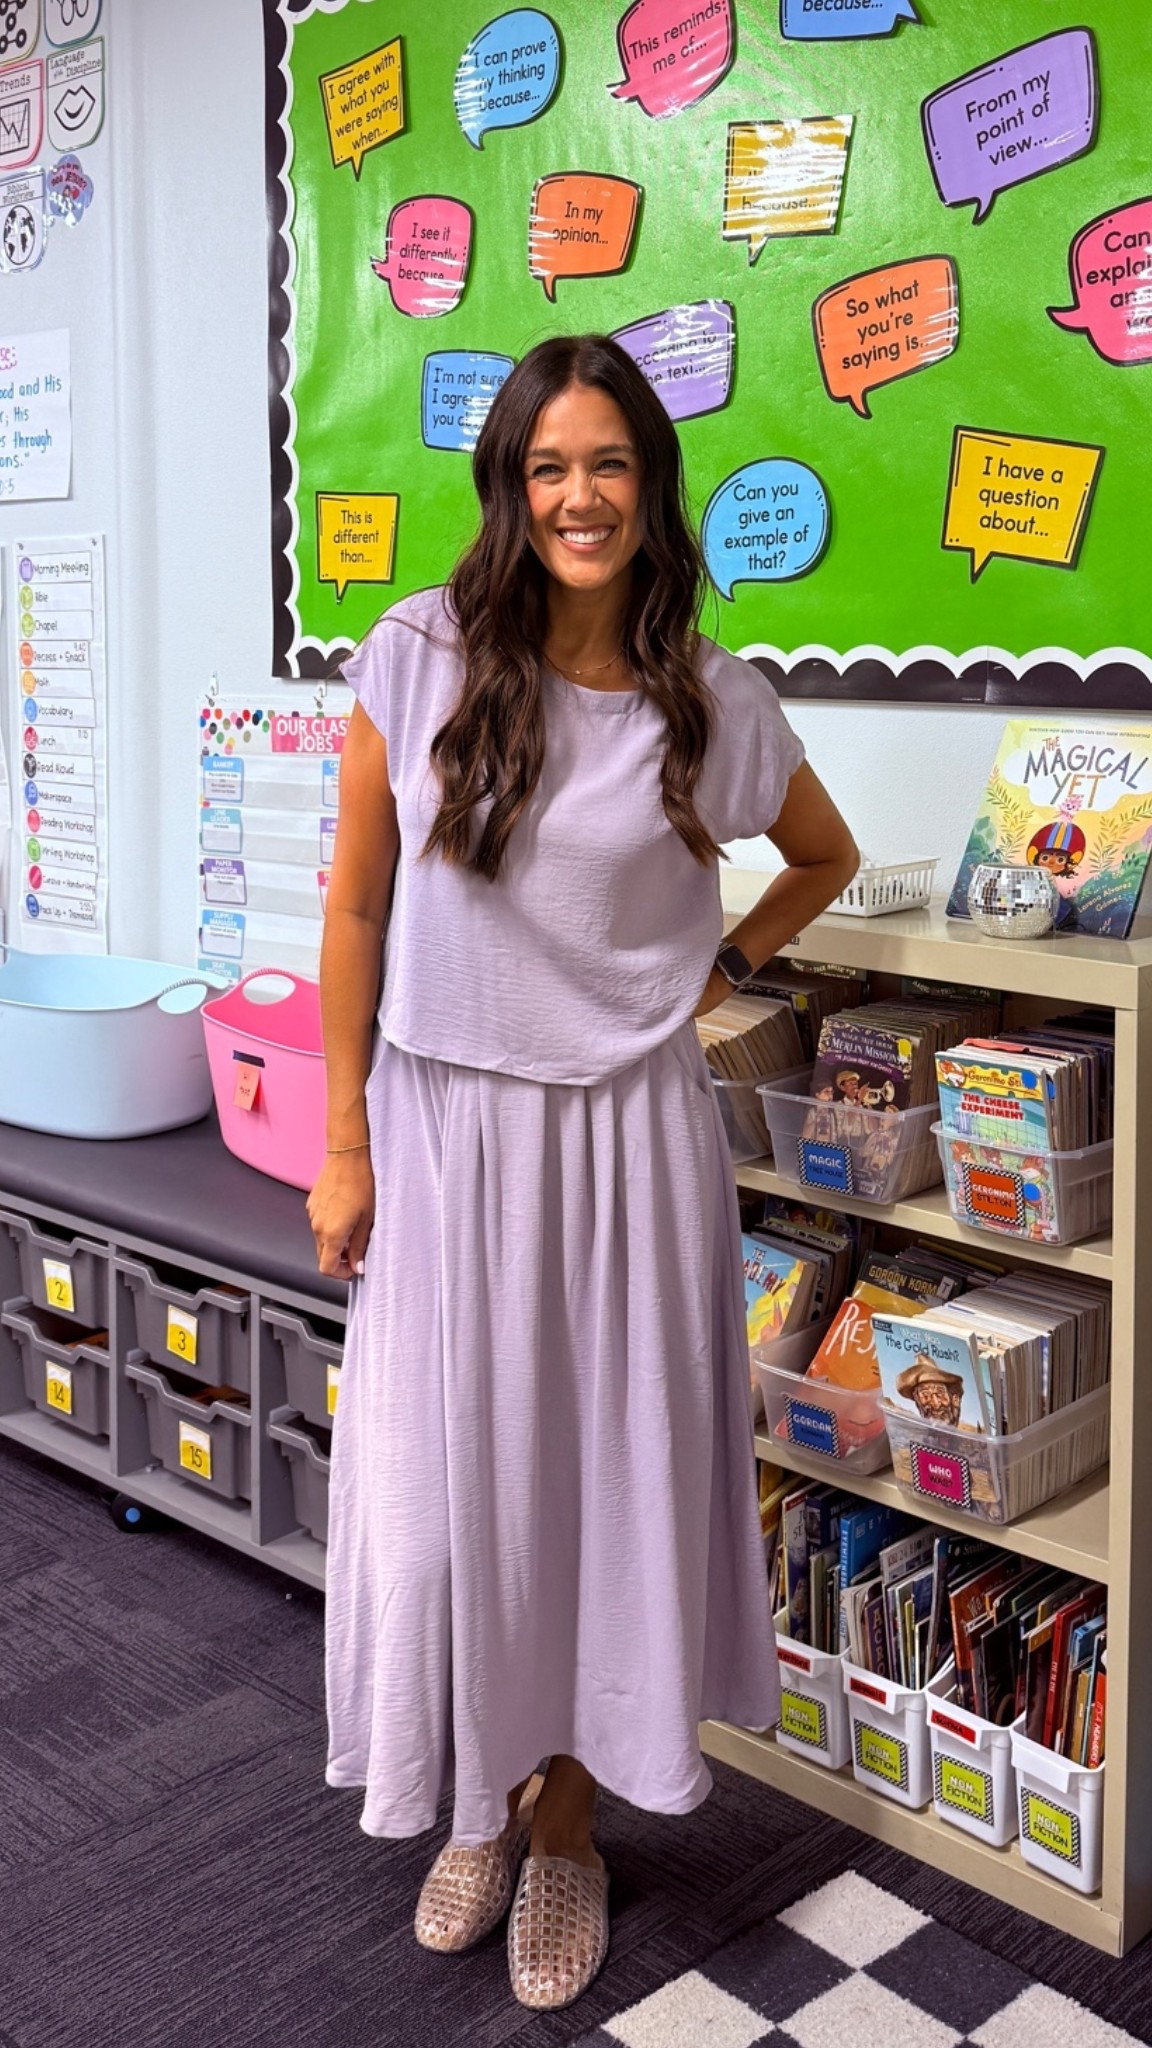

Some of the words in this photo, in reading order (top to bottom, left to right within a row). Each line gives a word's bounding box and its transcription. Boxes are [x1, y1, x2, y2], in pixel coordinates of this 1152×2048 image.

[629, 37, 659, 60] This
[663, 5, 721, 41] reminds
[473, 52, 480, 68] I
[484, 51, 508, 66] can
[511, 41, 547, 65] prove
[653, 52, 676, 74] me
[680, 36, 708, 57] of...
[0, 75, 31, 92] Trends
[328, 84, 335, 99] I
[338, 71, 371, 97] agree
[373, 52, 395, 73] with
[498, 63, 545, 86] thinking
[340, 95, 367, 115] what
[370, 80, 390, 101] you
[966, 89, 1016, 122] From
[1022, 70, 1050, 92] my
[335, 117, 363, 138] were
[365, 94, 398, 124] saying
[976, 107, 1024, 151] point
[1032, 92, 1050, 118] of
[351, 128, 388, 150] when...
[989, 135, 1048, 166] view...
[564, 201, 580, 219] In
[583, 207, 604, 225] my
[411, 222, 418, 238] I
[420, 227, 440, 240] see
[443, 226, 451, 241] it
[552, 226, 609, 245] opinion...
[1104, 231, 1151, 252] Can
[846, 298, 869, 318] So
[875, 279, 919, 309] what
[857, 311, 913, 344] you're
[635, 339, 697, 368] ccording
[842, 342, 900, 369] saying
[19, 377, 40, 397] and
[44, 374, 62, 393] His
[433, 367, 454, 384] I'm
[457, 370, 477, 384] not
[480, 374, 504, 387] sure
[644, 371, 662, 386] he
[432, 388, 438, 404] I
[441, 393, 474, 409] agre
[13, 406, 29, 422] His
[432, 414, 454, 429] you
[13, 429, 52, 454] through
[982, 456, 993, 476] I
[998, 458, 1044, 483] have
[1052, 470, 1063, 484] a
[733, 484, 766, 502] Can
[771, 482, 799, 504] you
[978, 486, 1059, 512] question
[341, 510, 361, 524] This
[365, 511, 373, 524] is
[739, 507, 770, 529] give
[775, 507, 795, 522] an
[979, 514, 1049, 537] about...
[333, 529, 379, 543] different
[724, 528, 788, 550] example
[793, 525, 810, 543] of
[340, 549, 372, 563] than...
[747, 550, 786, 571] that?
[61, 562, 89, 576] Meeting
[35, 619, 58, 635] Chapel
[65, 651, 86, 662] Snack
[38, 705, 73, 719] Vocabulary
[277, 719, 309, 735] OUR
[311, 719, 349, 736] CLAS
[296, 735, 334, 752] JOBS
[1042, 736, 1060, 751] THE
[56, 764, 74, 775] Aloud
[1023, 744, 1149, 789] MAGICAL
[1050, 772, 1107, 808] YET
[40, 816, 63, 831] Reading
[64, 818, 94, 834] Workshop
[64, 849, 95, 866] Workshop
[831, 1038, 862, 1053] MERLIN
[968, 1070, 1005, 1085] Geronimo
[961, 1102, 1024, 1120] EXPERIMENT
[963, 1093, 981, 1103] THE
[984, 1097, 1020, 1109] CHEESE
[808, 1154, 842, 1168] MAGIC
[972, 1184, 1015, 1200] GERONIMO
[977, 1193, 1012, 1208] STILTON
[869, 1265, 907, 1286] GORDON
[55, 1281, 64, 1301] 2
[177, 1331, 186, 1351] 3
[886, 1334, 901, 1349] the
[904, 1339, 929, 1355] Gold
[931, 1345, 960, 1362] Rush?
[53, 1382, 65, 1403] 14
[793, 1414, 832, 1433] GORDAN
[189, 1446, 203, 1468] 15
[928, 1464, 952, 1478] WHO
[929, 1475, 952, 1488] WAS?
[786, 1715, 817, 1735] FICTION
[865, 1751, 897, 1774] FICTION
[946, 1785, 982, 1808] FICTION
[1034, 1822, 1068, 1848] FICTION
